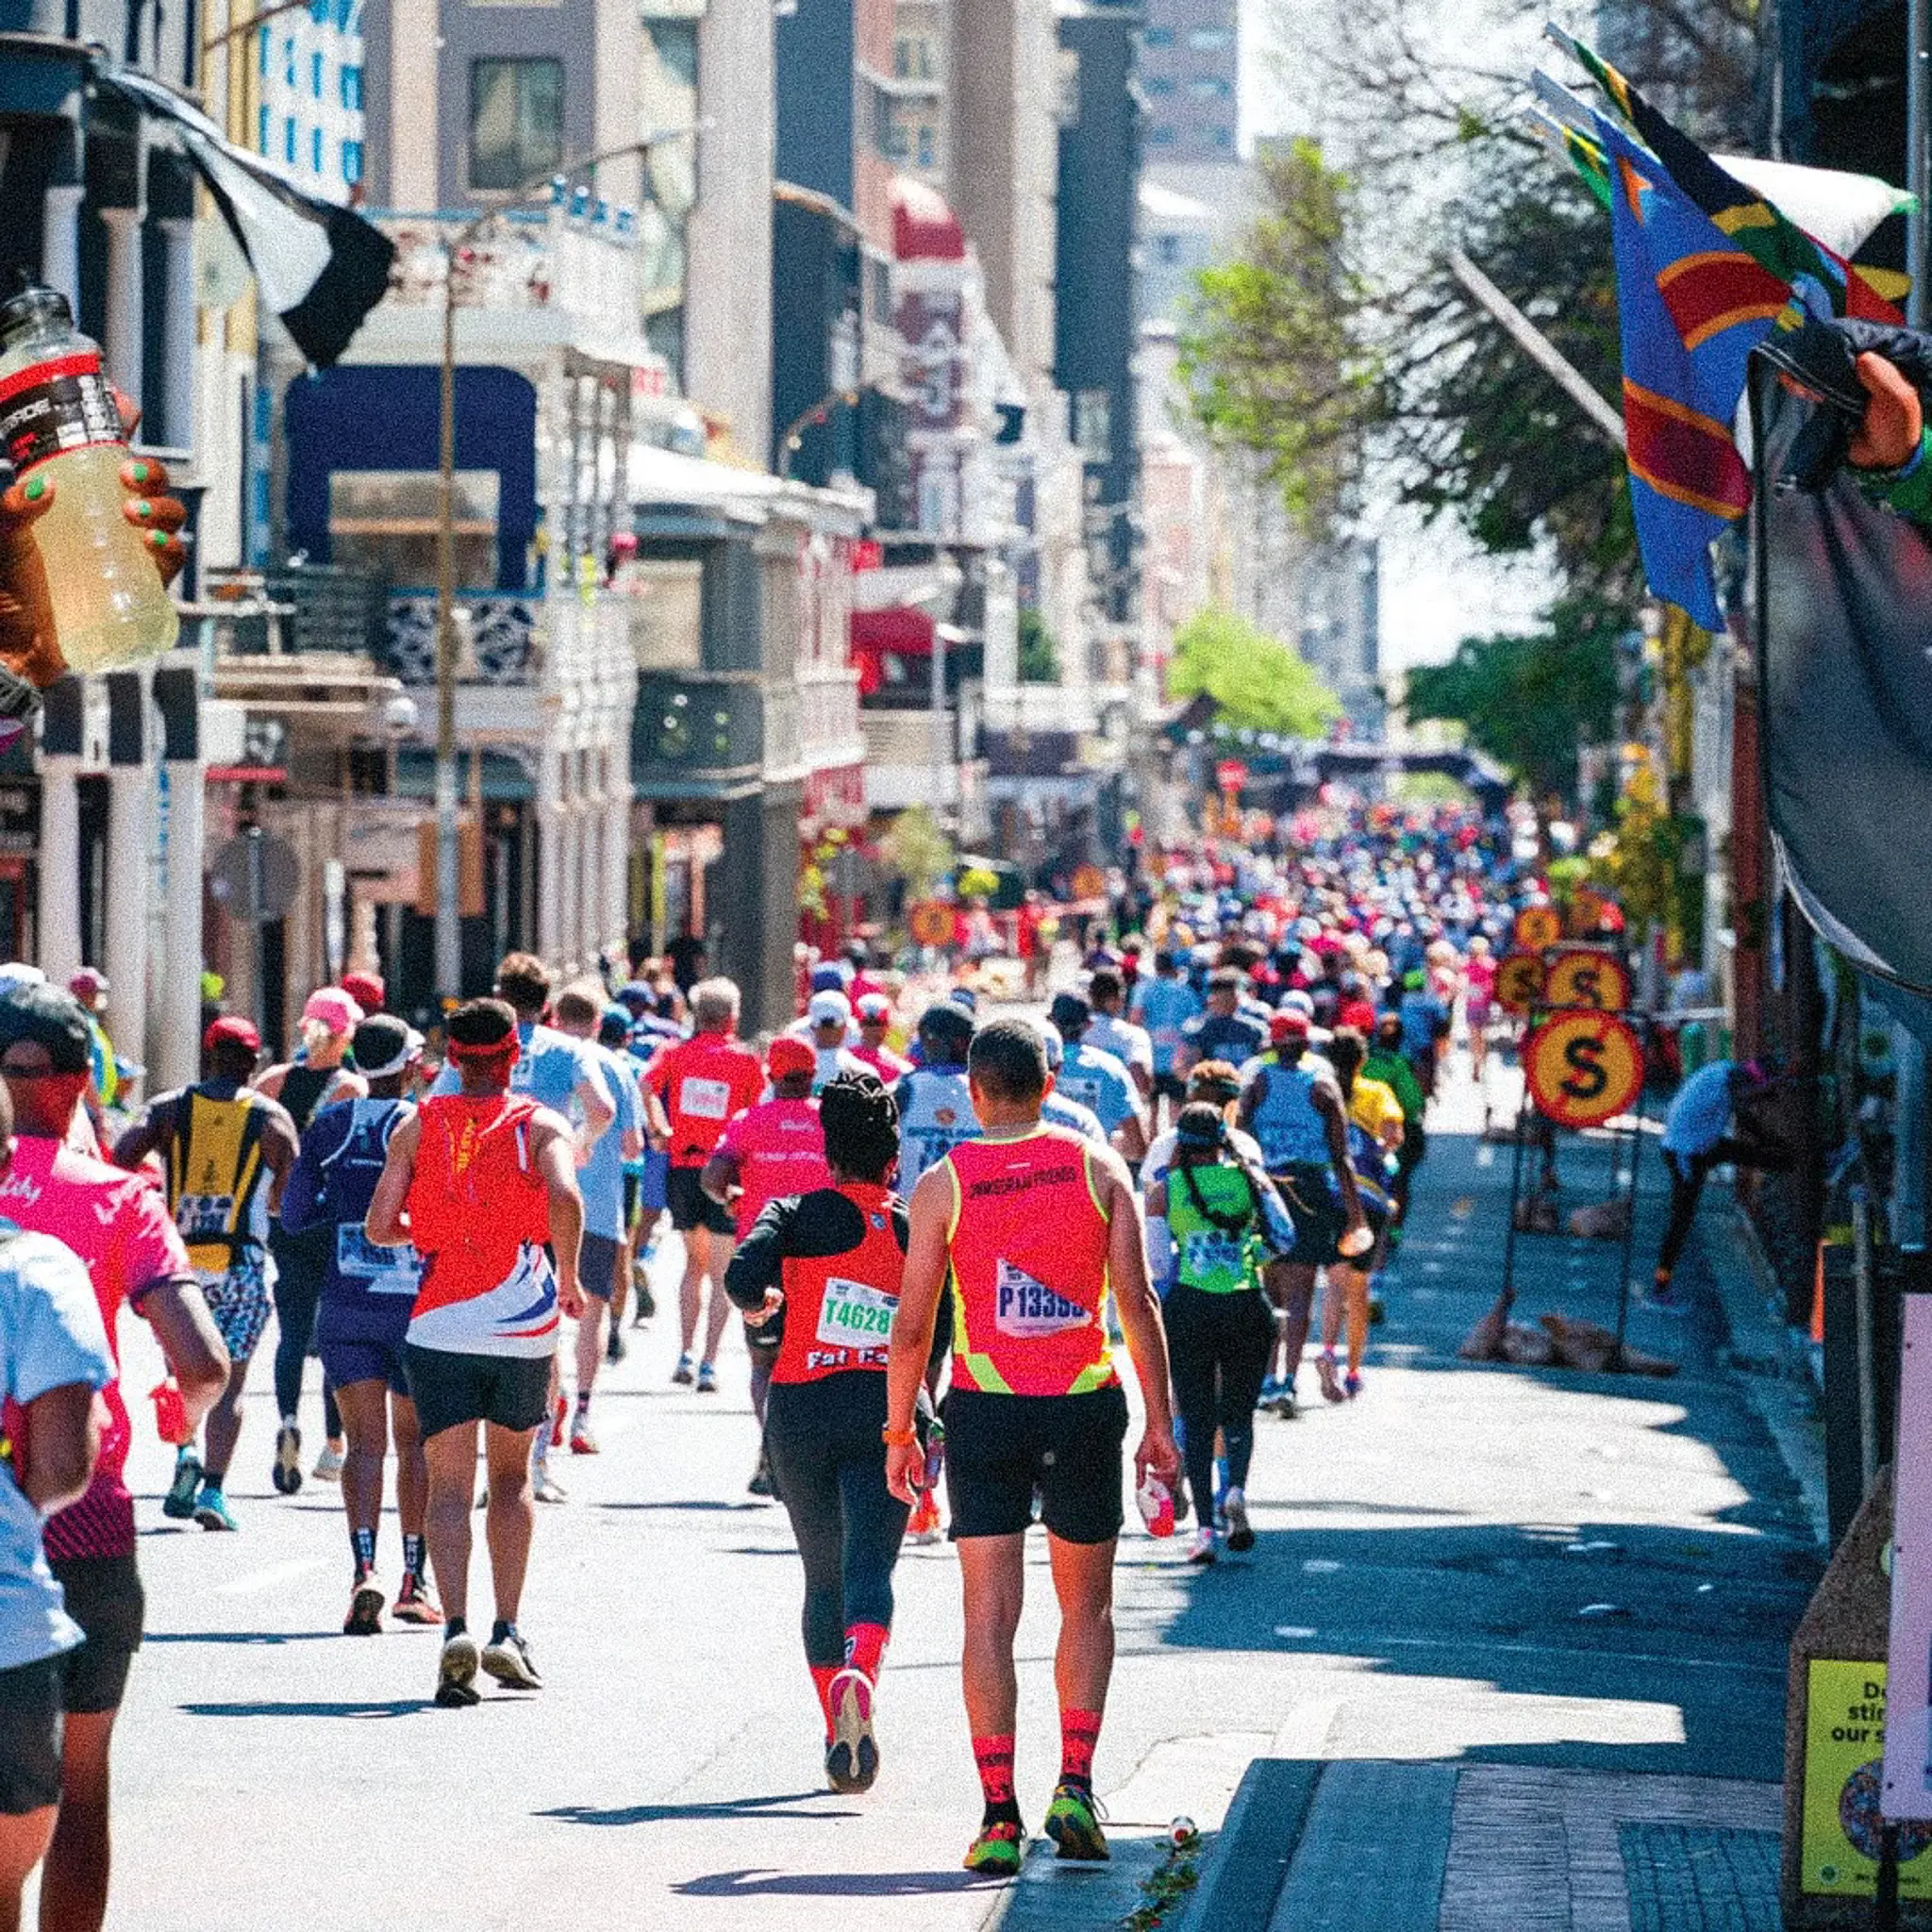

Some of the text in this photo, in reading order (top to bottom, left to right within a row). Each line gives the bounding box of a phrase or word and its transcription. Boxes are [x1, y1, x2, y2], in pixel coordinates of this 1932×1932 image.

[1559, 1036, 1608, 1099] S
[825, 1298, 892, 1334] T4628
[1831, 1726, 1871, 1742] our
